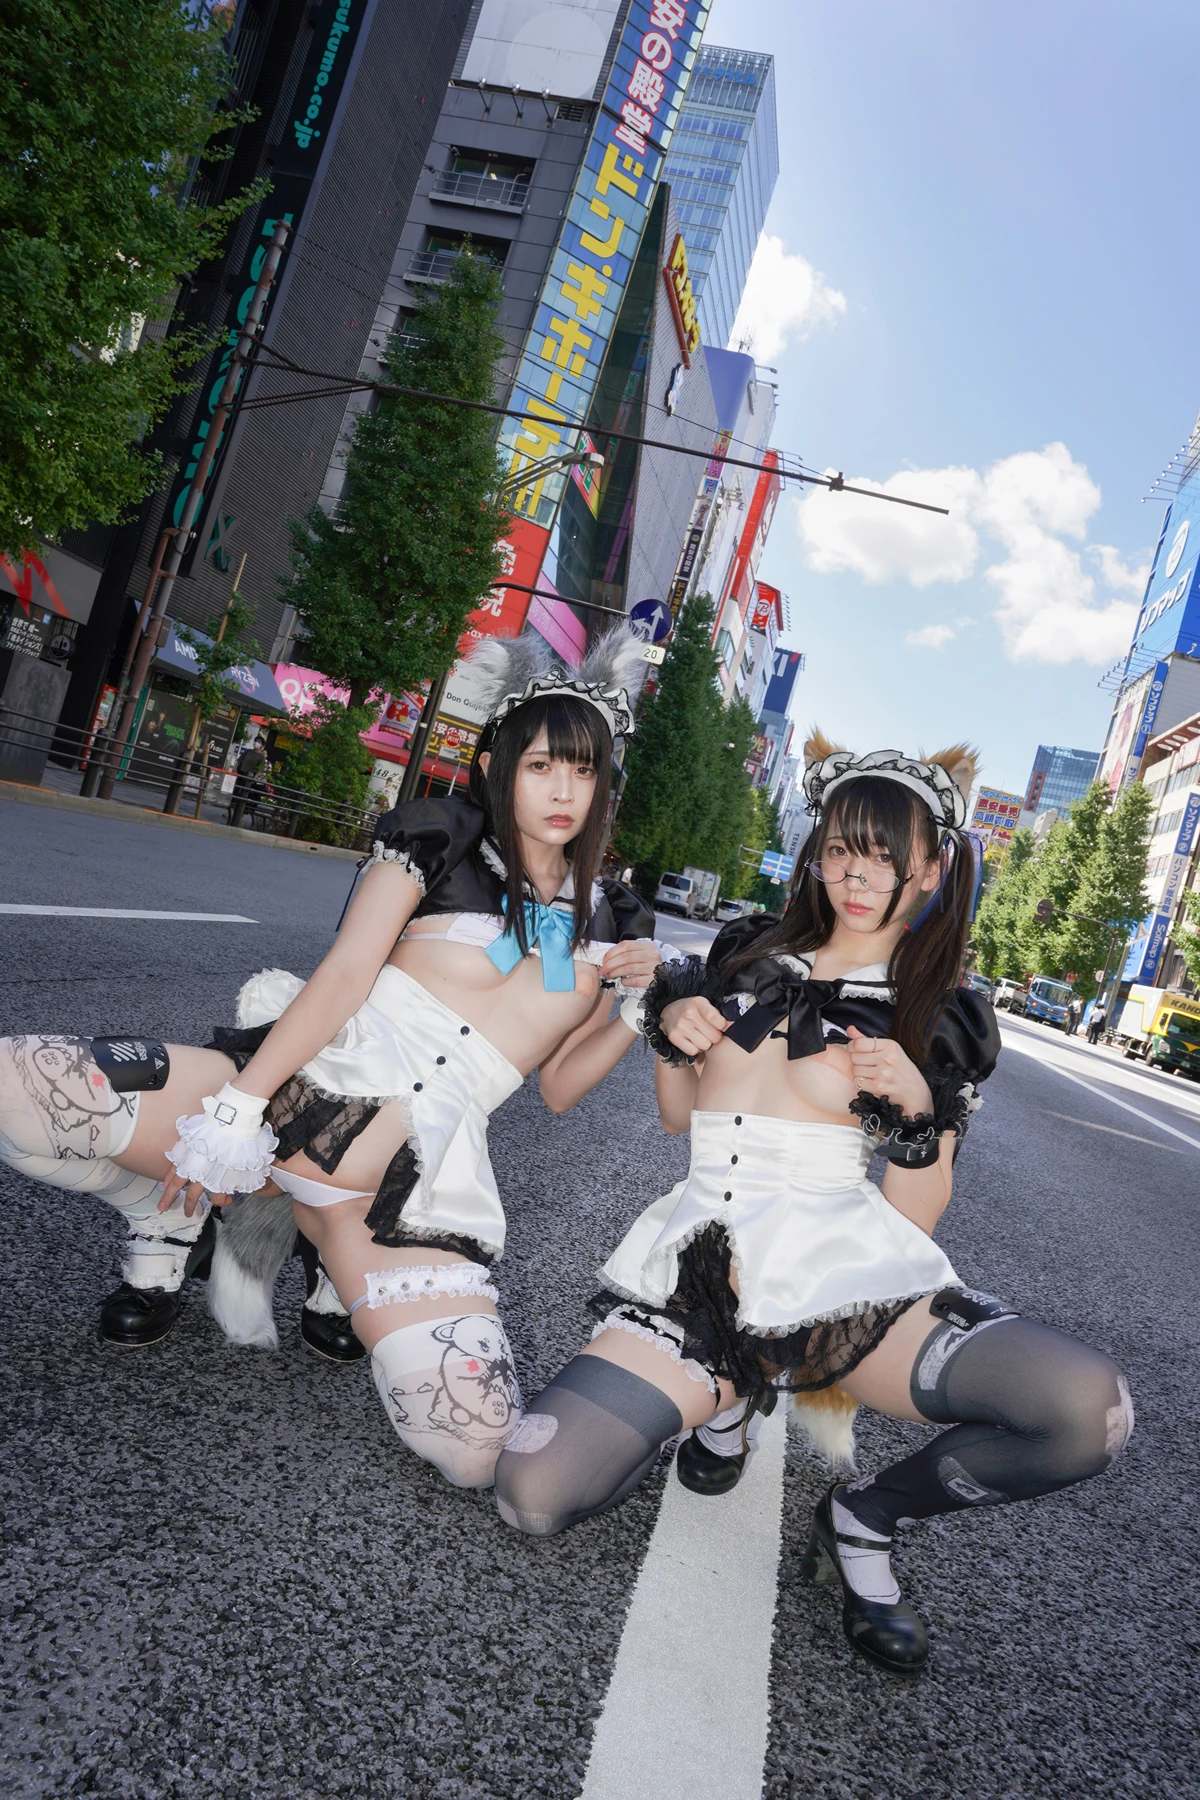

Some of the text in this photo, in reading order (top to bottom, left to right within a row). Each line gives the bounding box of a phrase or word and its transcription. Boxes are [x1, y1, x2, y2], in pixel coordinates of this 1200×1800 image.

[174, 640, 198, 661] AMD
[230, 665, 260, 688] RYZEN
[446, 692, 461, 703] Don
[1149, 924, 1166, 959] Sofmap
